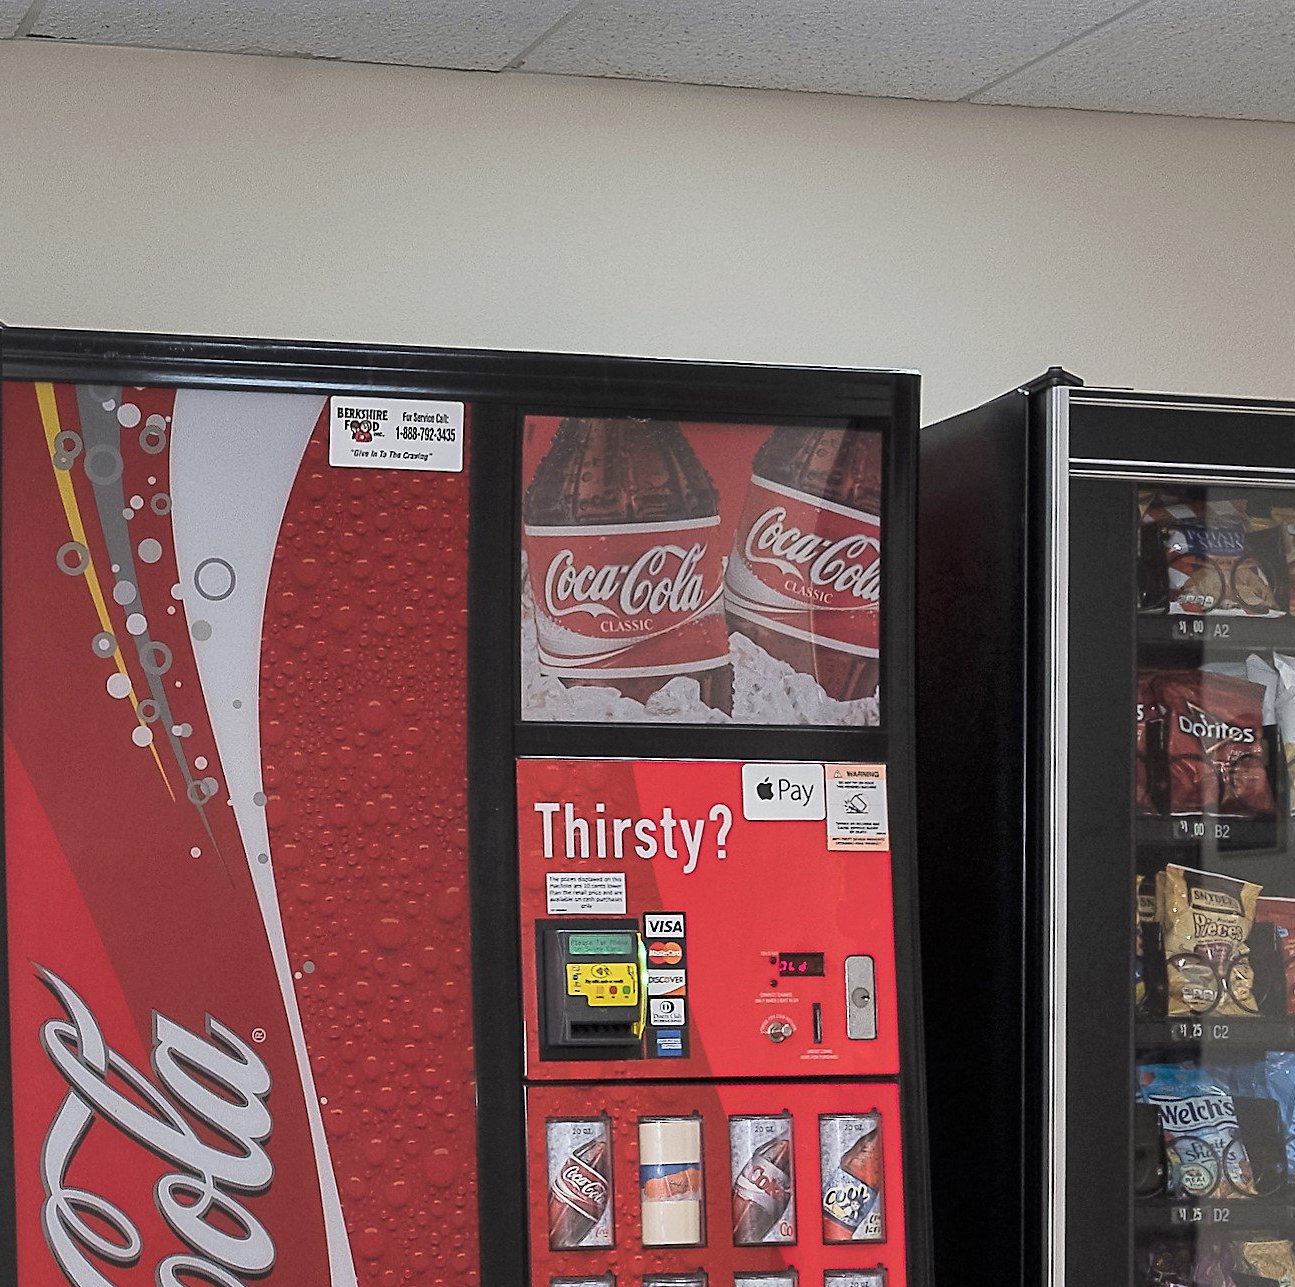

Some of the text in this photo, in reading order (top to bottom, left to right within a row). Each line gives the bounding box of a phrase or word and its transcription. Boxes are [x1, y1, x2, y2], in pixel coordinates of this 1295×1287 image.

[337, 407, 389, 421] BERKSHIRE
[402, 411, 413, 422] For
[413, 412, 435, 424] Service
[396, 426, 456, 442] 1-888-792-3435
[545, 541, 704, 619] Coca-Cola
[784, 578, 835, 604] CLASSIC
[599, 618, 655, 633] CLASSIC
[1214, 624, 1229, 637] A2
[1178, 715, 1255, 743] Doritos
[779, 779, 815, 807] Pay
[534, 802, 733, 874] Thirsty?
[1215, 825, 1230, 838] B2
[649, 920, 683, 933] VISA
[648, 976, 684, 984] DISCOVER
[1214, 1025, 1229, 1038] C2
[1160, 1100, 1235, 1124] Welch's
[1214, 1209, 1229, 1221] D2
